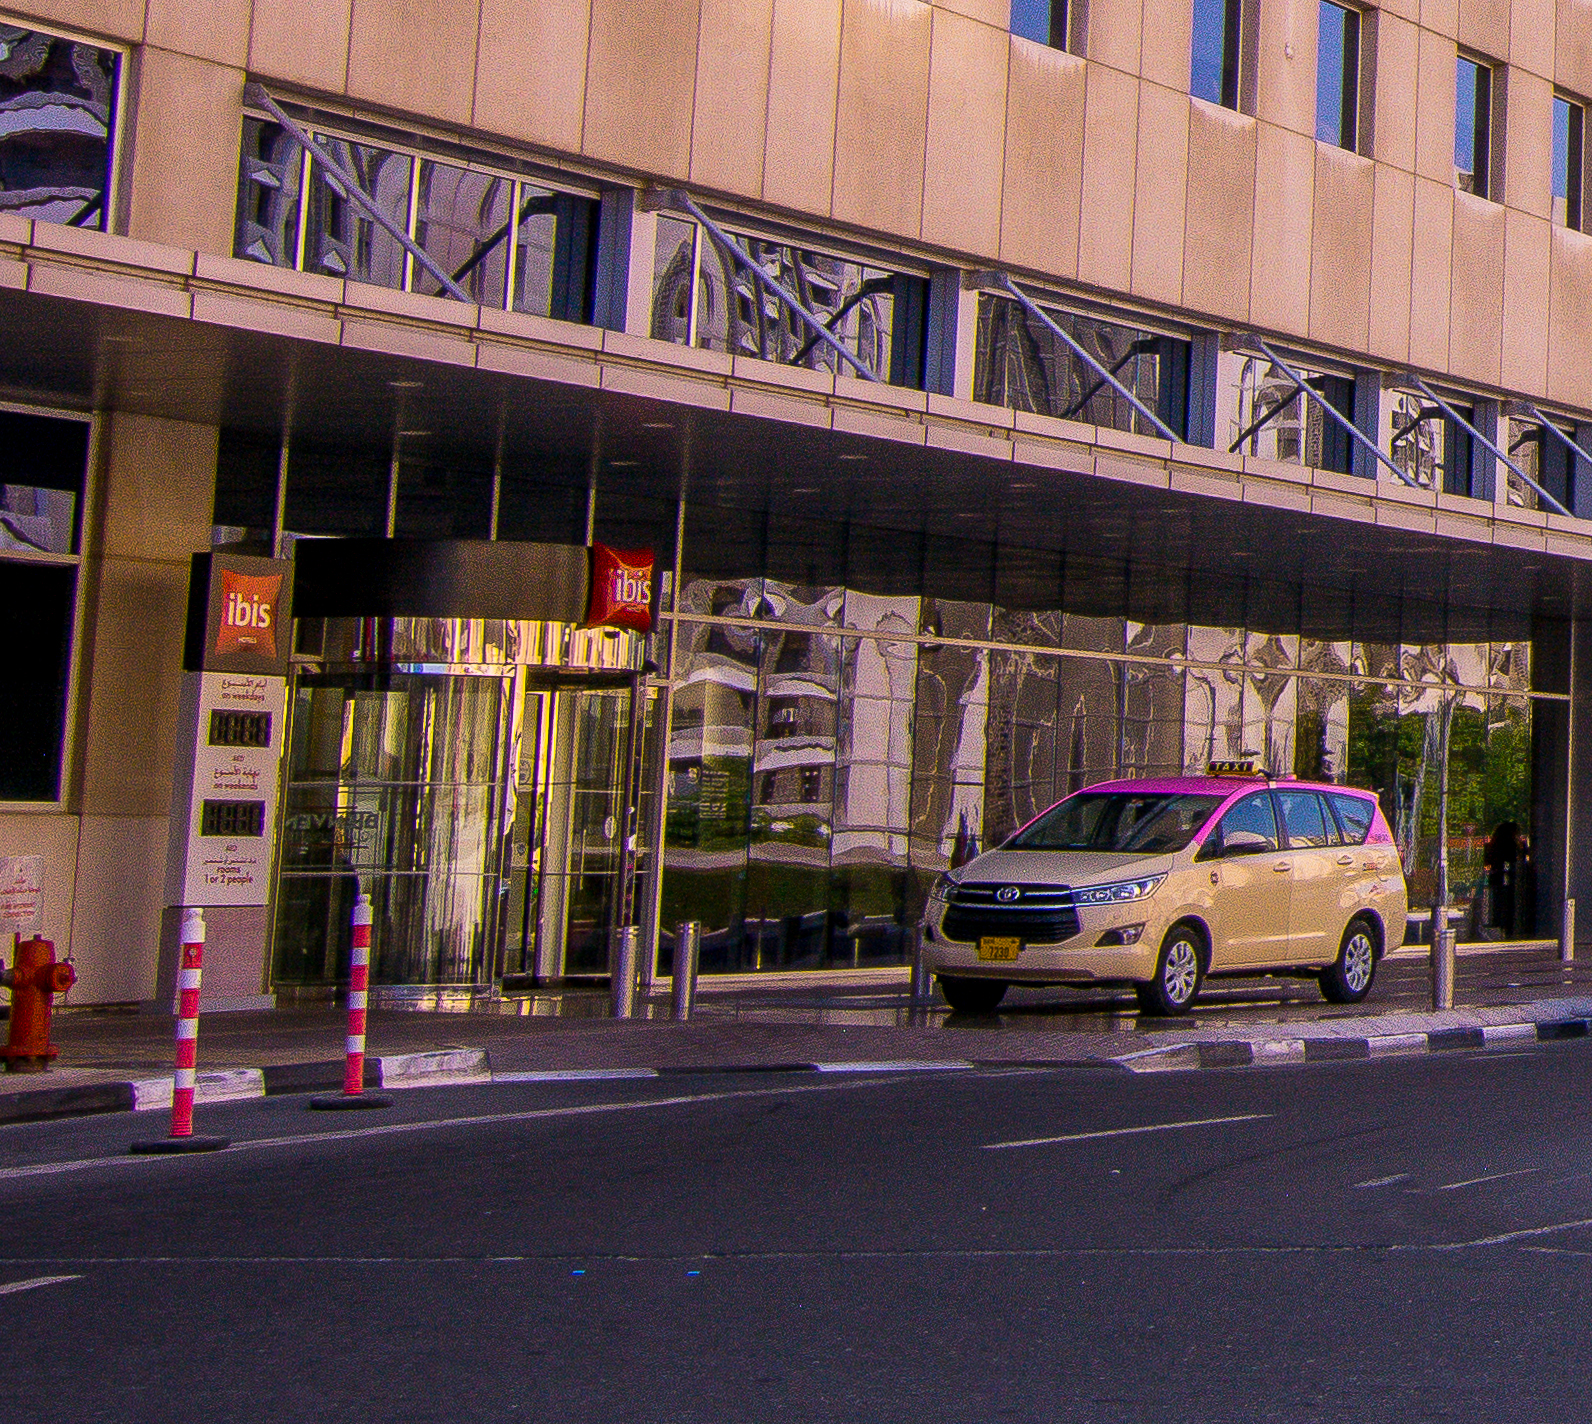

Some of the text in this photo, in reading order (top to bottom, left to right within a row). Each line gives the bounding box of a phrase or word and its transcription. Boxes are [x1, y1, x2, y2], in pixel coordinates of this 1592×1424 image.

[616, 569, 652, 604] ibis
[227, 592, 271, 628] ibis
[1216, 762, 1247, 771] TAXI
[227, 871, 253, 886] people
